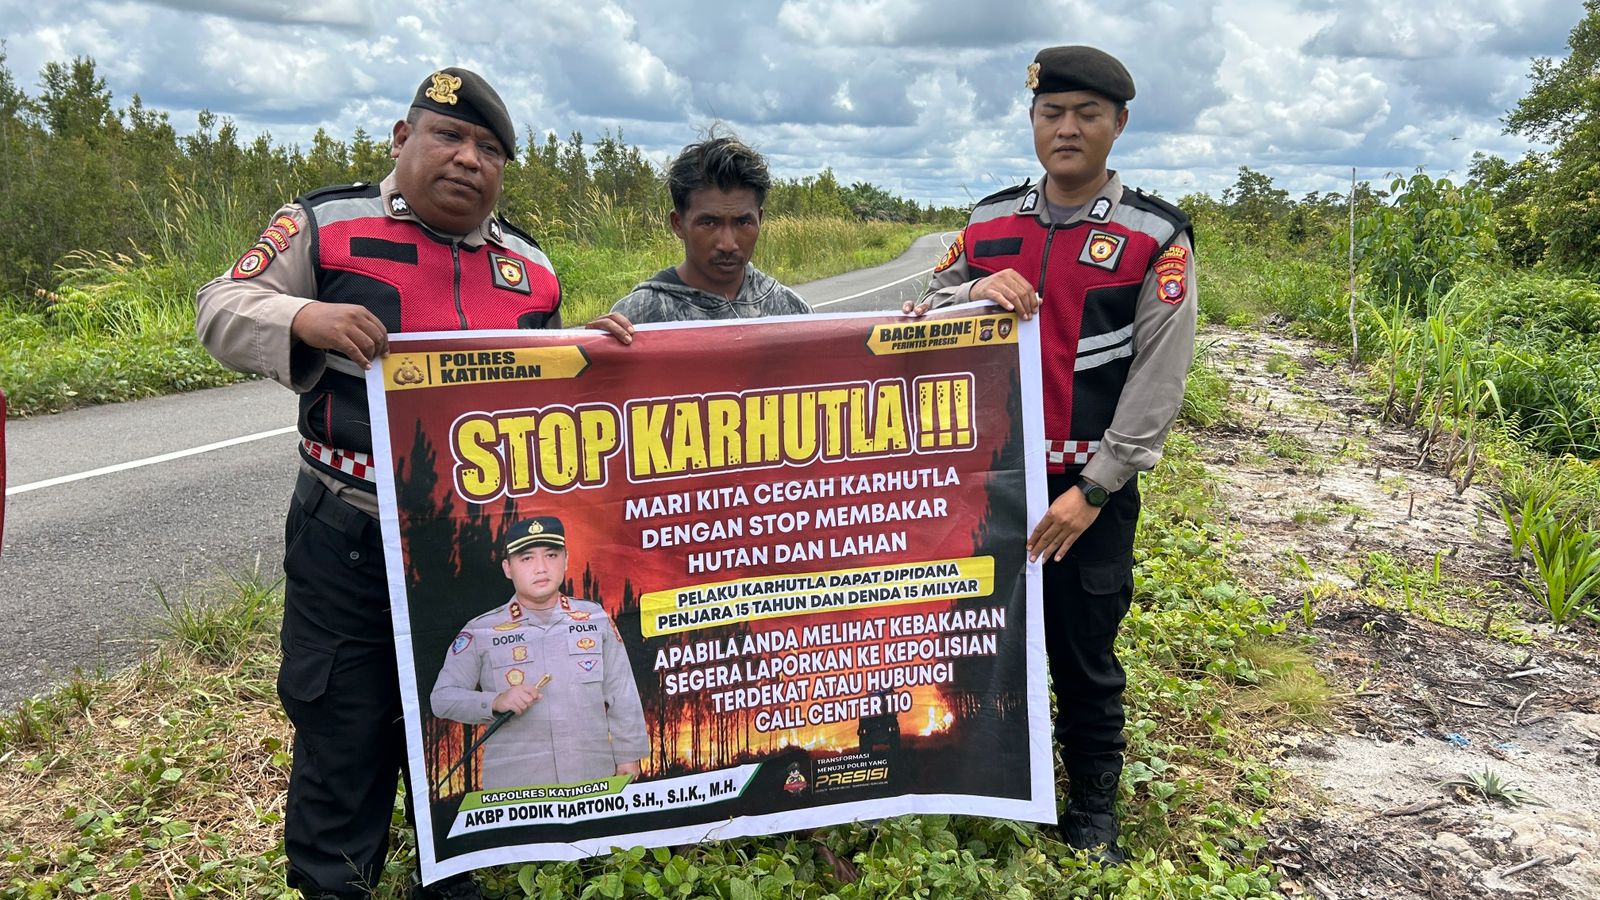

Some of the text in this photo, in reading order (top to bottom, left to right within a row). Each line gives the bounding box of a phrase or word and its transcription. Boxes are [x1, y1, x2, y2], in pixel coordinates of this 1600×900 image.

[880, 324, 926, 343] BACK
[930, 320, 972, 337] BONE
[892, 336, 958, 350] PERINTIS PRESISI
[439, 351, 516, 367] POLRES
[441, 365, 541, 384] KATINGAN
[456, 378, 972, 497] STOP KARHUTLA !!!
[625, 466, 961, 521] MARI KITA CEGAH KARHUTLA
[641, 498, 948, 549] DENGAN STOP MEMBAKAR
[688, 531, 907, 574] HUTAN DAN LAHAN
[657, 578, 978, 630] PENJARA 15 TAHUN DAN DENDA 15 MILYAR
[678, 563, 959, 607] PELAKU KARHUTLA DAPAT DIPIDANA
[492, 633, 526, 646] DODIK
[568, 624, 598, 634] POLRI
[653, 608, 1005, 671] APABILA ANDA MELIHAT KEBAKARAN
[664, 634, 997, 696] SEGERA LAPORKAN KE KEPOLISIAN
[711, 662, 954, 713] TERDEKAT ATAU HUBUNGI
[755, 691, 912, 733] CALL CENTER 110
[815, 767, 889, 788] PRESISI
[817, 753, 870, 765] TRANSFORMASI
[817, 764, 846, 774] MENUJU
[847, 762, 867, 770] POLRI
[464, 779, 737, 828] AKBP DODIK HARTONO, S.H., S.I.K., M.H.
[481, 781, 609, 803] KAPOLRES KATINGAN
